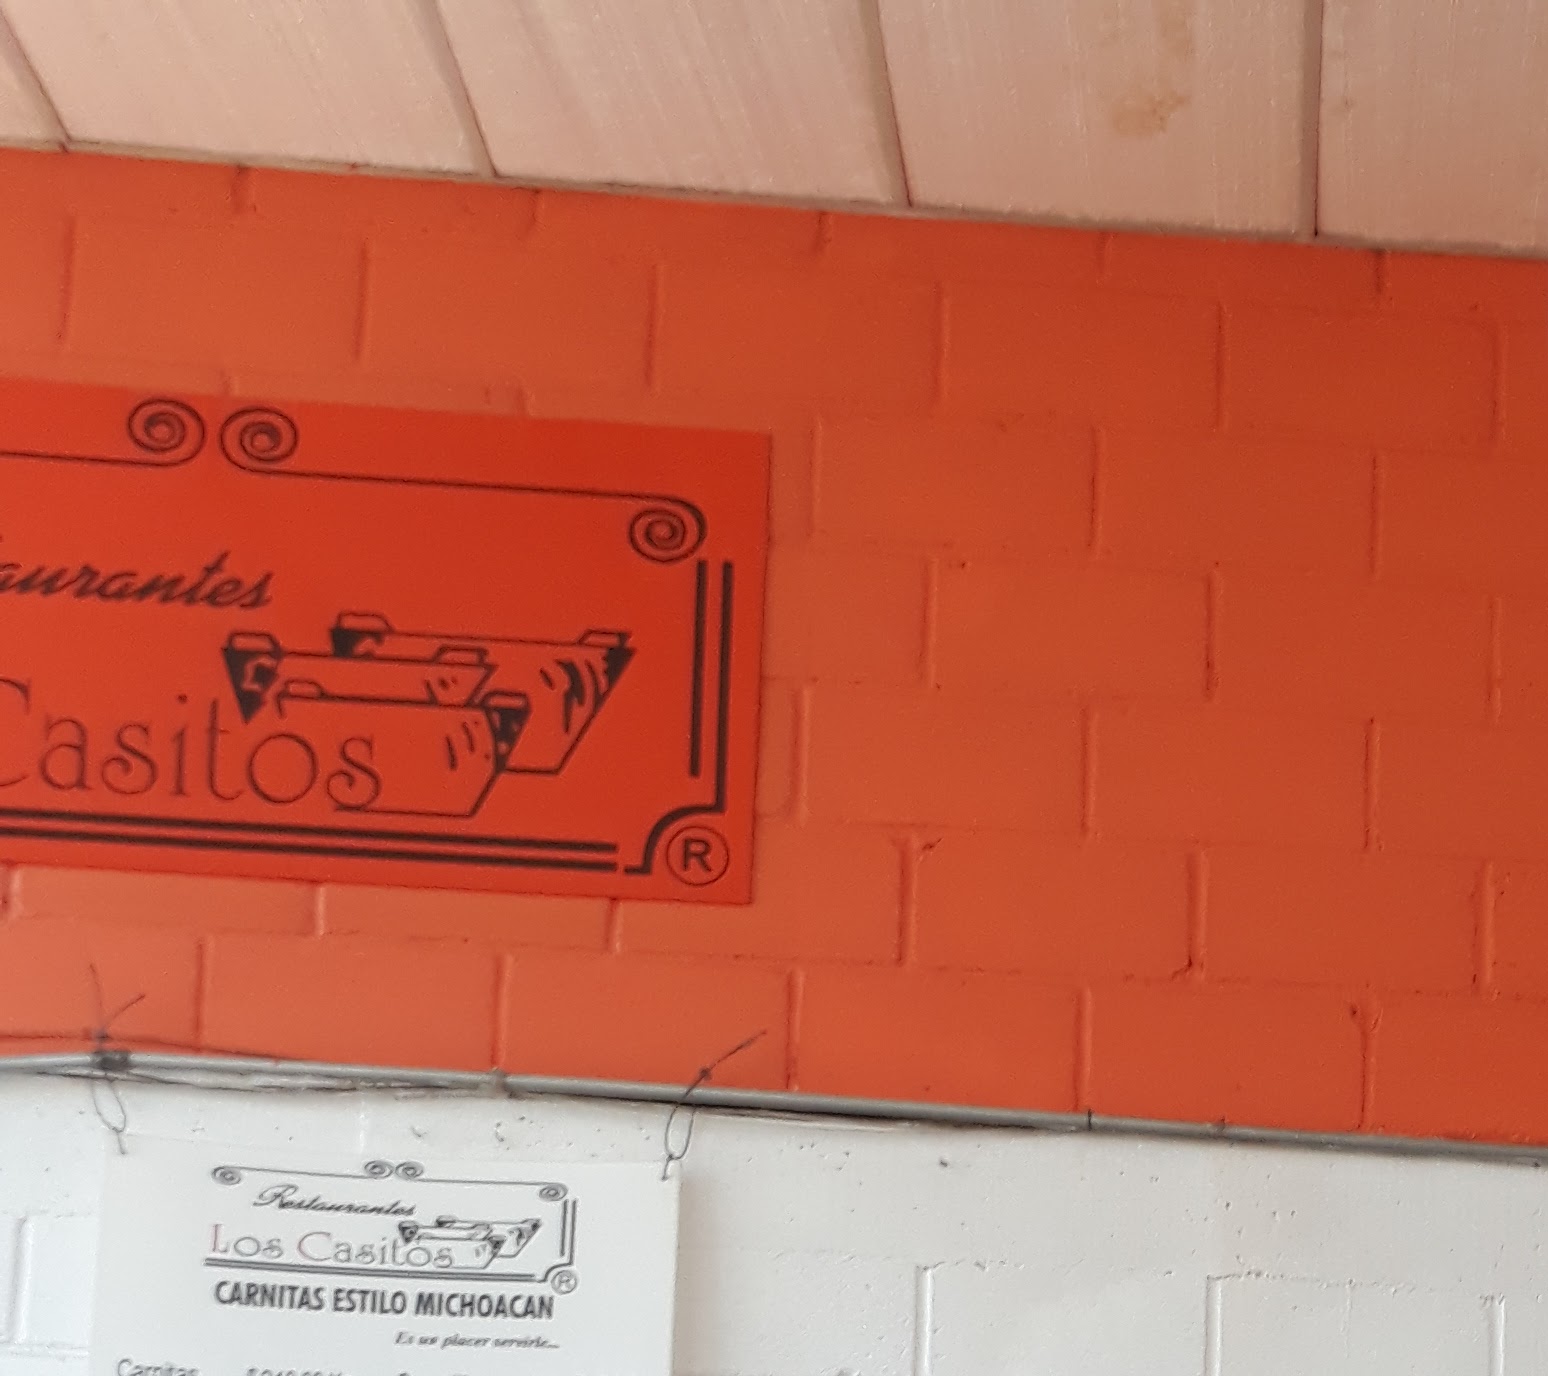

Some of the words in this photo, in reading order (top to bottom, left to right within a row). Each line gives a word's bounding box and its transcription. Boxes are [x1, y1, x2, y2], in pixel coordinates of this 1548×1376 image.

[251, 1184, 417, 1217] Restaurantes
[209, 1222, 284, 1259] Los
[298, 1231, 453, 1269] Casitos
[215, 1280, 324, 1311] CARNITAS
[332, 1287, 407, 1315] ESTILO
[414, 1290, 554, 1320] MICHOACAN
